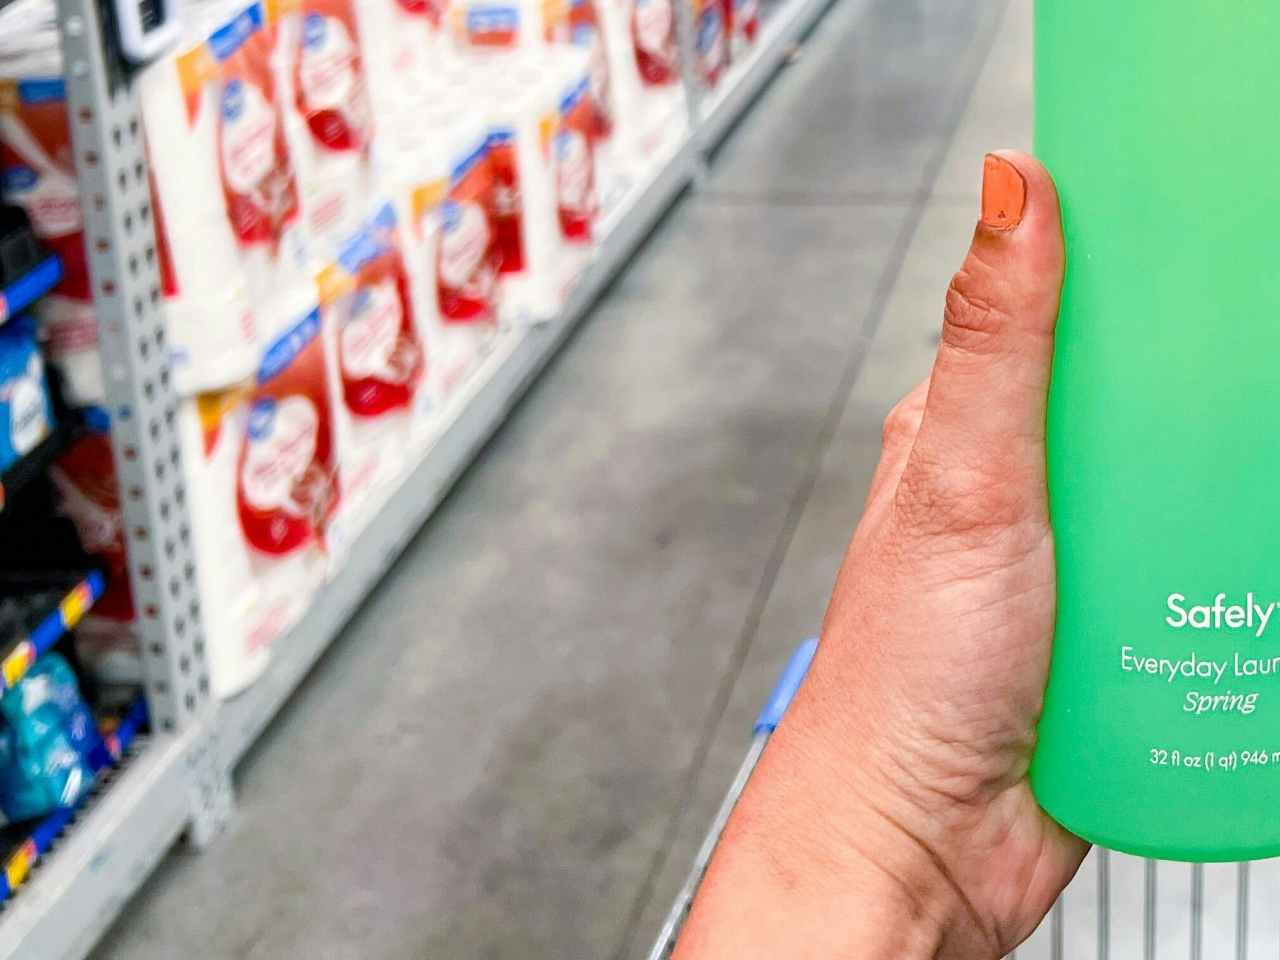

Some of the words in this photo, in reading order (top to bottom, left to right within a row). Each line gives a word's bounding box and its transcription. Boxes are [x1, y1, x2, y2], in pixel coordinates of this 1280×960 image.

[1121, 645, 1227, 683] Everyday
[1183, 691, 1259, 714] Spring
[1150, 749, 1168, 765] 32
[1171, 750, 1180, 766] fl
[1183, 756, 1201, 768] oz
[1204, 751, 1214, 770] (1
[1218, 751, 1237, 770] qt)
[1240, 750, 1268, 765] 946
